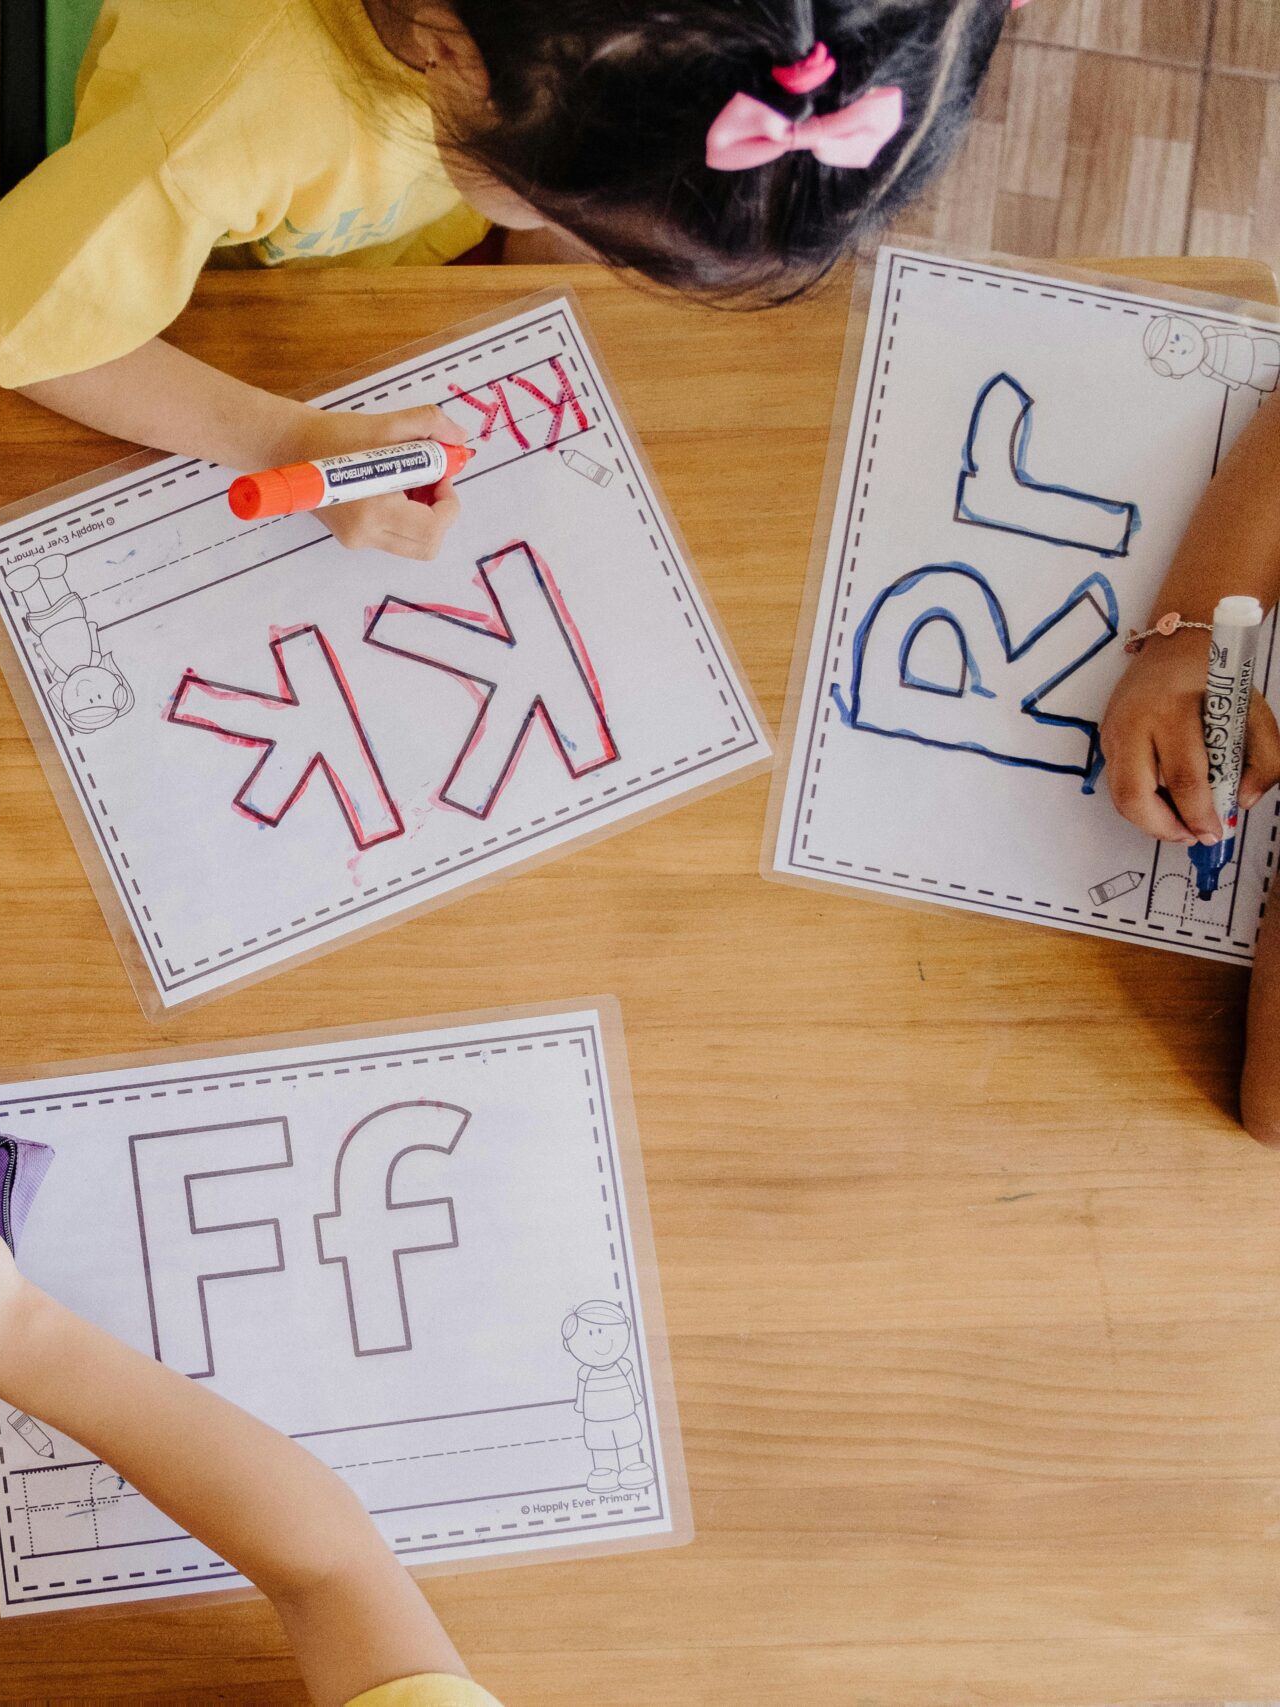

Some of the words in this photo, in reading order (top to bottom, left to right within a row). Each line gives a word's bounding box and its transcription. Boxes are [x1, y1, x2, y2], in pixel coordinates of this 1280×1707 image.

[374, 458, 403, 474] BLANCA
[47, 534, 70, 550] Ever
[70, 519, 105, 541] Happily
[5, 543, 46, 568] Primary
[832, 373, 1140, 794] Rr
[165, 540, 620, 849] Kk
[1237, 659, 1253, 714] PIZARRA
[131, 1101, 470, 1377] Ff
[534, 1501, 569, 1513] Happily
[573, 1500, 595, 1508] Ever
[600, 1493, 640, 1504] Primary
